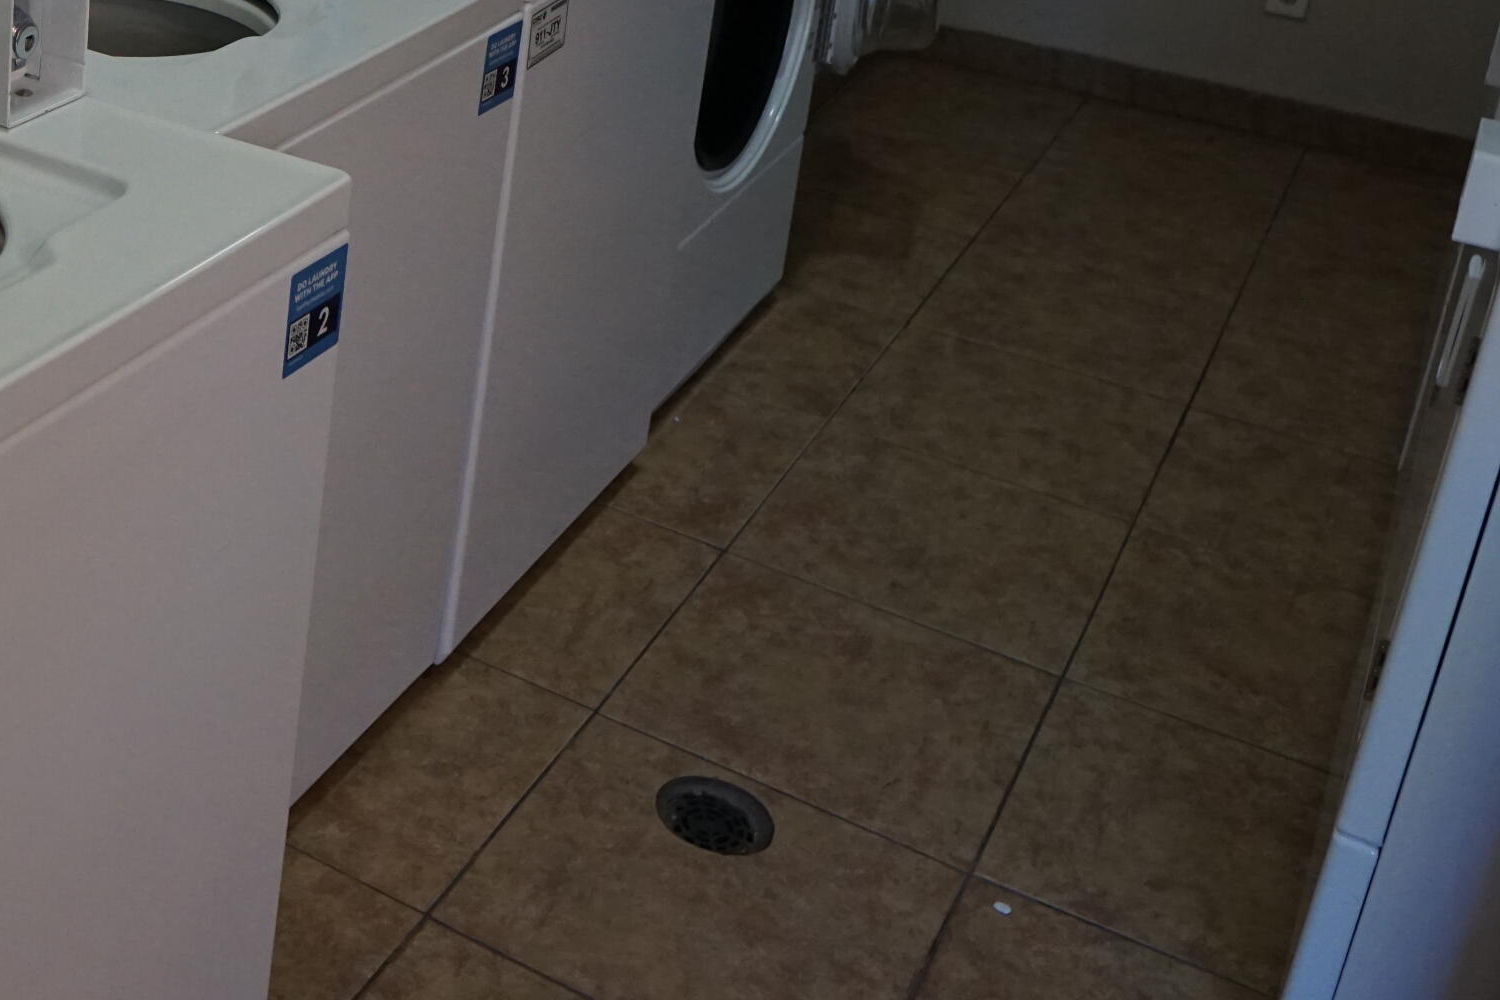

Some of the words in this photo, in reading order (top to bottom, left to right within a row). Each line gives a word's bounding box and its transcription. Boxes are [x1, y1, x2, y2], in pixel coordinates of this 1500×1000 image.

[501, 66, 510, 88] 3
[297, 279, 308, 292] DO
[316, 306, 330, 337] 2
